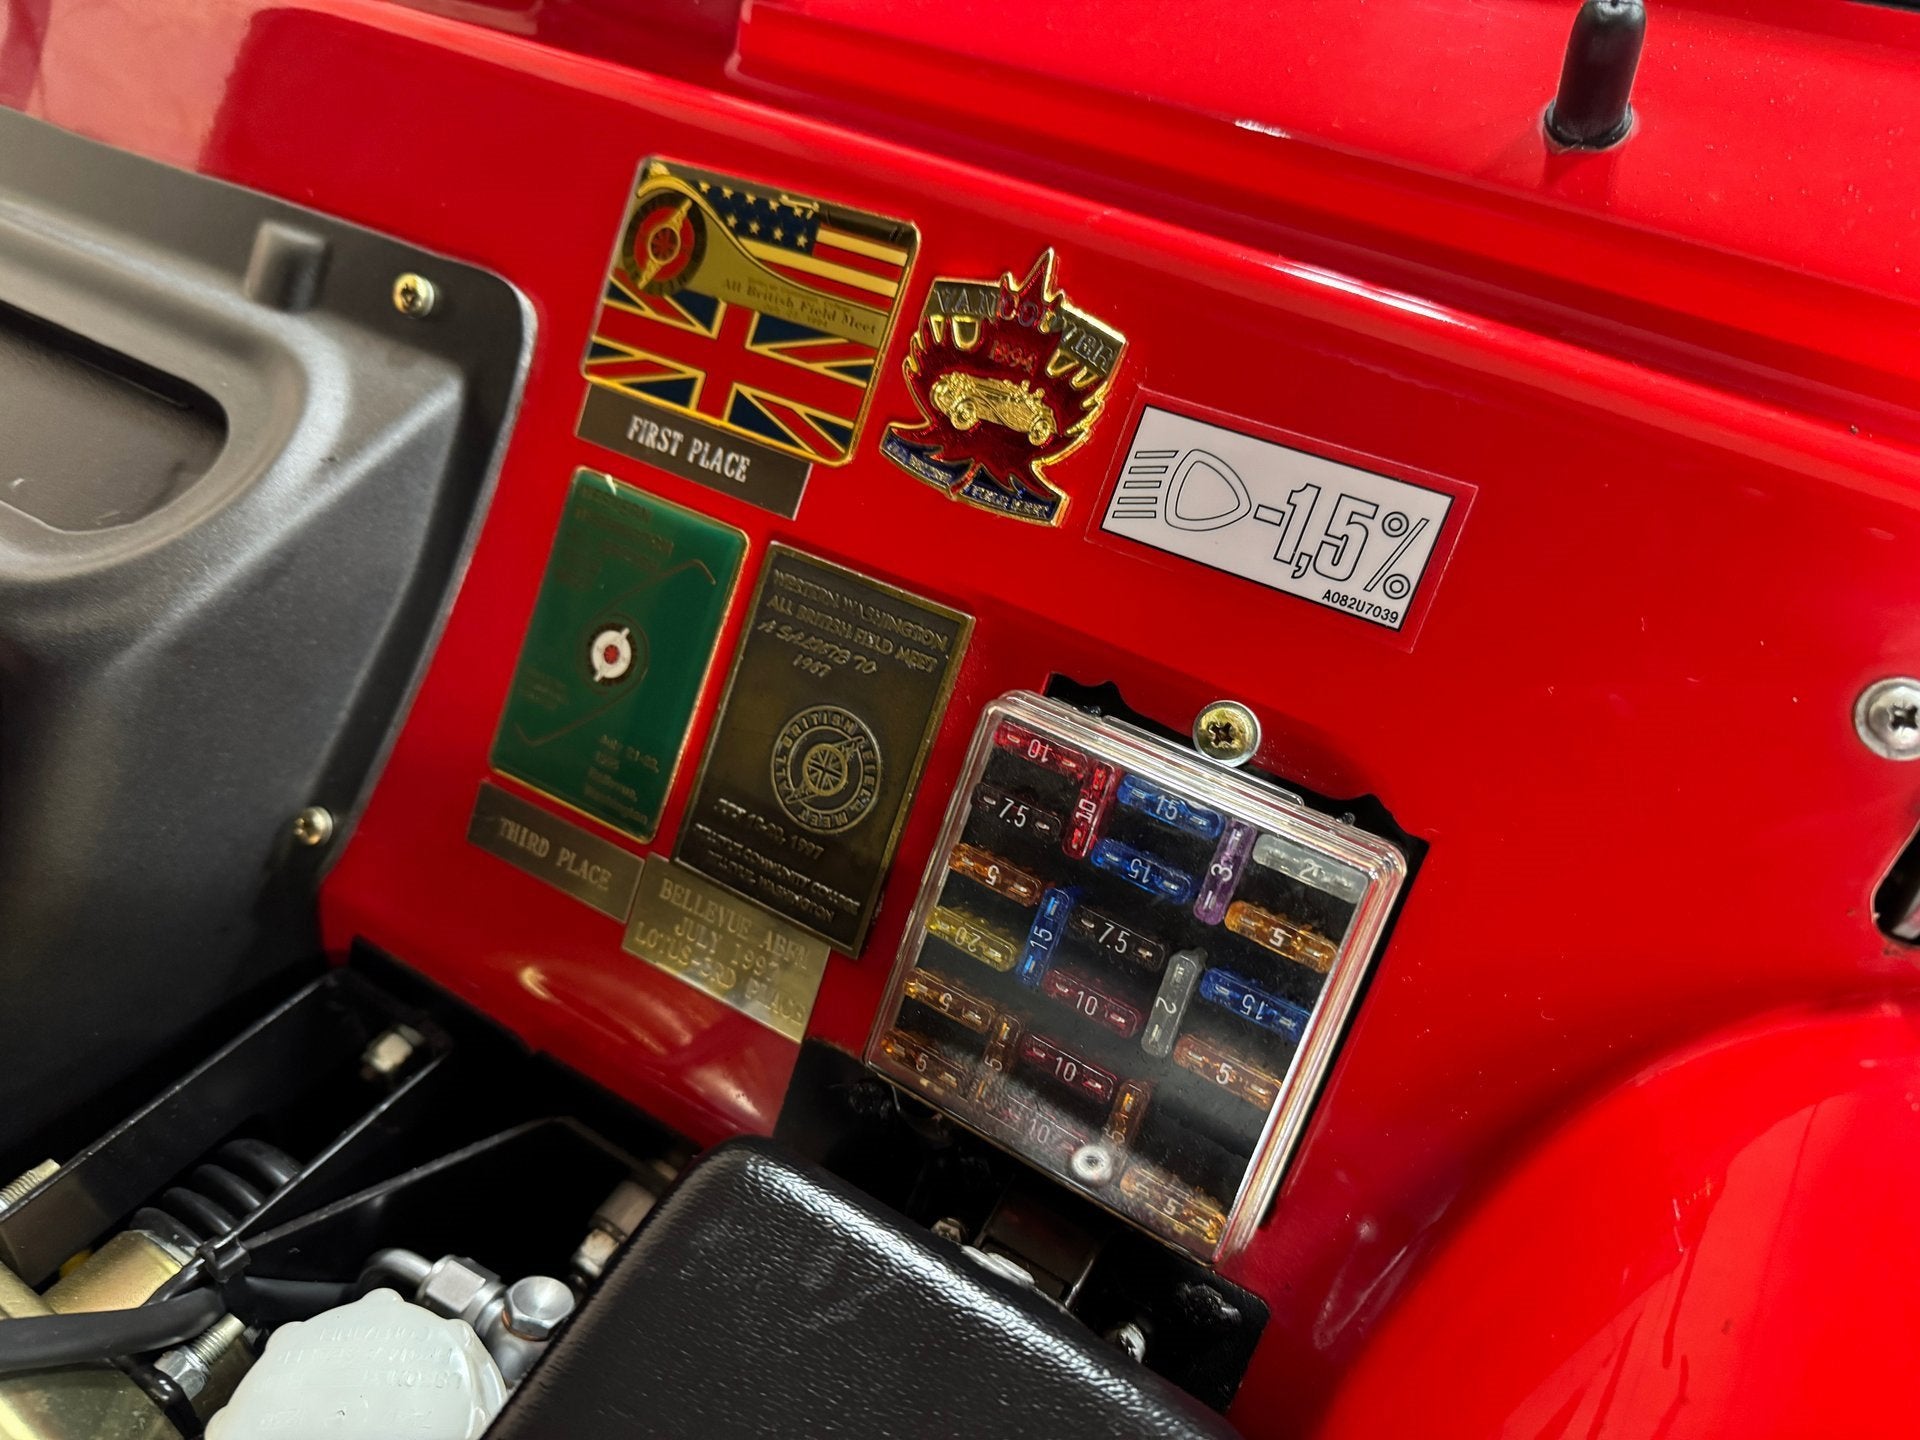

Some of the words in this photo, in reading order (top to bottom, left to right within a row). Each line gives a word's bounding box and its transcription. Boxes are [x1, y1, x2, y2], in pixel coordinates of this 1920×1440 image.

[746, 282, 794, 310] British
[799, 298, 838, 325] Field
[840, 312, 878, 336] Meet
[626, 414, 685, 459] FIRST
[688, 438, 750, 484] PLACE
[1253, 483, 1430, 600] -1,5%
[1321, 589, 1399, 624] A082U7039
[766, 594, 793, 617] ALL
[795, 604, 853, 640] BRITISH
[853, 626, 894, 656] FIELD
[895, 645, 938, 673] MEET
[843, 596, 948, 651] WASHINGTON
[782, 712, 858, 750] BRITISH
[1027, 738, 1050, 763] 10
[797, 810, 849, 829] MEET
[998, 797, 1030, 829] 7.5
[1074, 799, 1097, 825] 10
[1155, 794, 1180, 821] 15
[498, 815, 551, 860] THIRD
[555, 842, 613, 892] PLACE
[985, 864, 1001, 887] 5
[1127, 858, 1152, 885] 15
[1209, 863, 1234, 882] 3
[659, 877, 753, 941] BELLEVUE
[674, 916, 723, 955] JULY
[954, 926, 982, 953] 20
[1029, 927, 1053, 951] 15
[1098, 921, 1131, 954] 7.5
[1269, 925, 1289, 948] 5
[938, 992, 953, 1013] 5
[1075, 990, 1099, 1017] 10
[1155, 996, 1177, 1015] 2
[1239, 993, 1265, 1021] 15
[914, 1052, 929, 1073] 5
[984, 1054, 1003, 1072] 5
[1055, 1056, 1077, 1082] 10
[1215, 1062, 1234, 1086] 5
[1027, 1118, 1050, 1144] 10
[1162, 1197, 1184, 1217] 5
